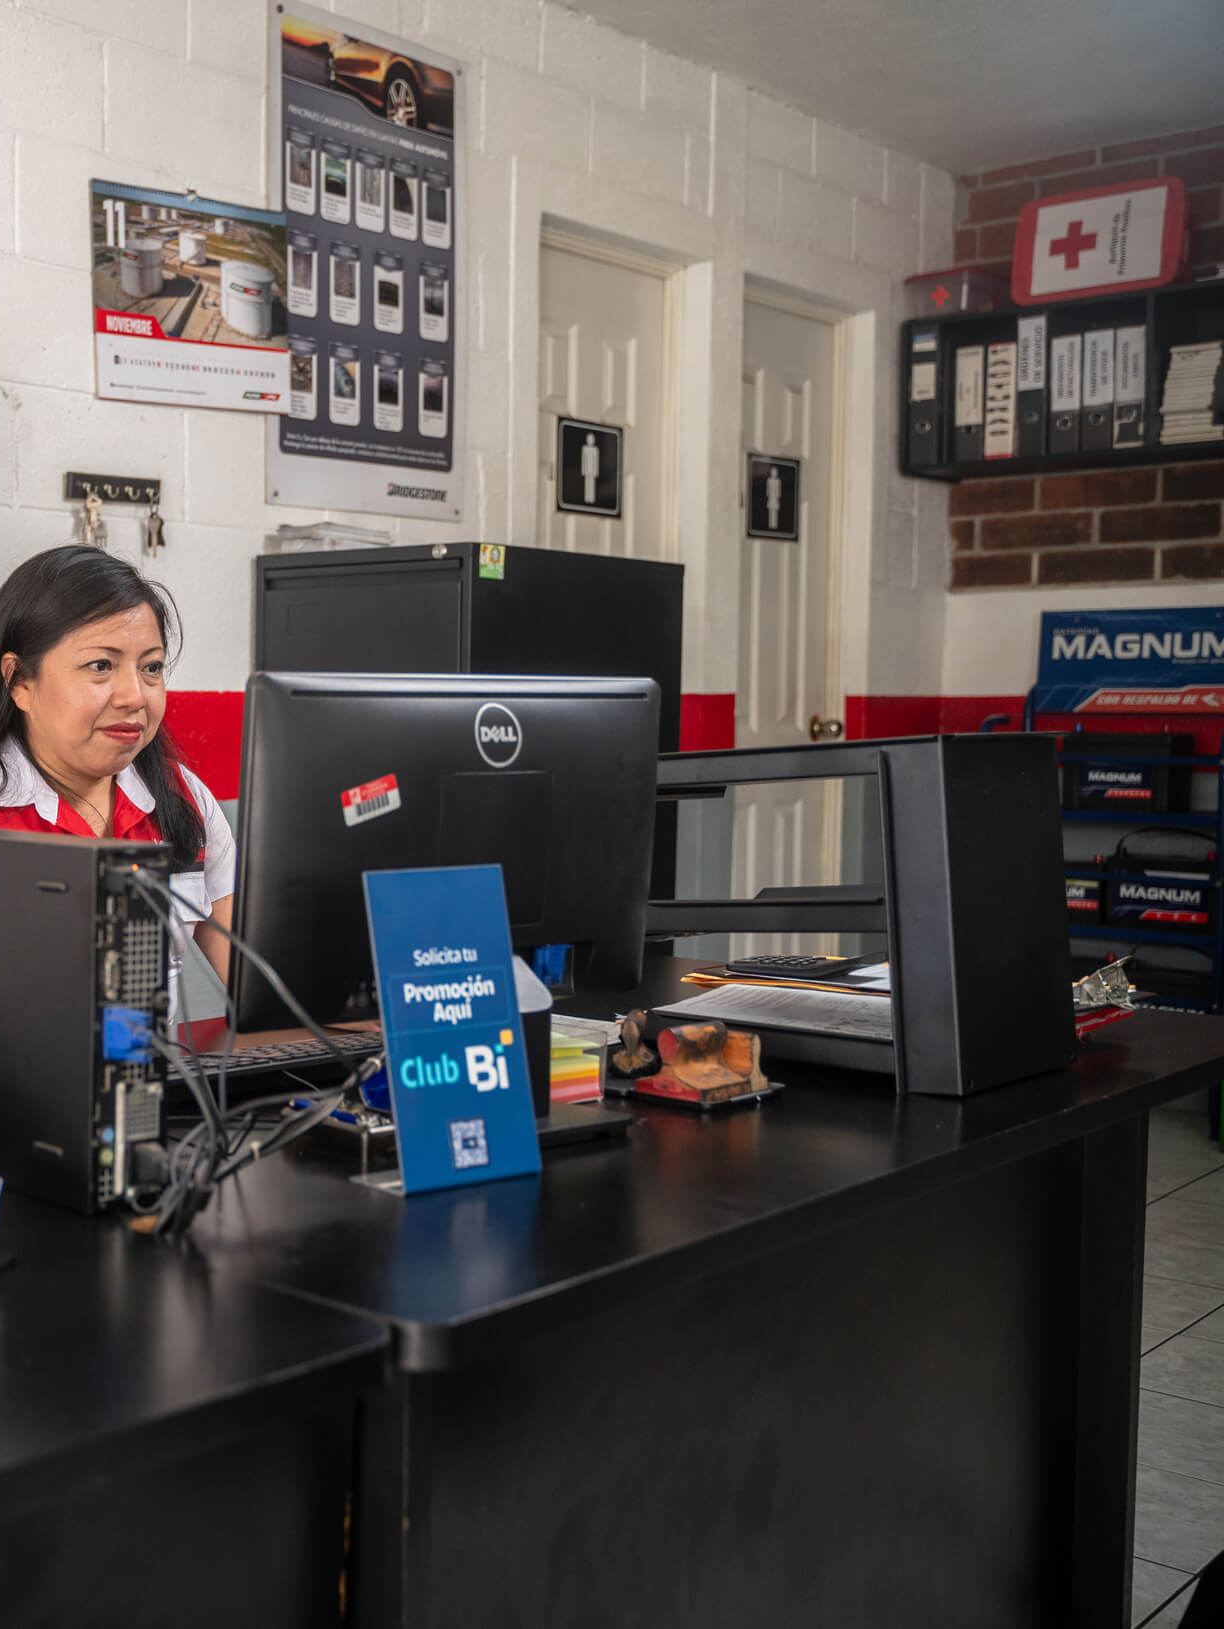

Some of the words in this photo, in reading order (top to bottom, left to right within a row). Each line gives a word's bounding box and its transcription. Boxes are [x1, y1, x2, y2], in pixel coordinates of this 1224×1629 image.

[103, 199, 126, 249] 11
[106, 314, 152, 336] NOVIEMBRE
[387, 482, 448, 503] BRIDGESTONE
[1051, 632, 1224, 660] MAGNUM
[480, 725, 518, 742] DELL
[1088, 771, 1142, 784] MAGNUM
[1119, 884, 1201, 904] MAGNUM
[413, 947, 461, 967] Solicita
[462, 947, 478, 962] tu
[403, 974, 495, 1004] Promoción
[400, 1052, 460, 1089] Club
[465, 1044, 510, 1092] Bi
